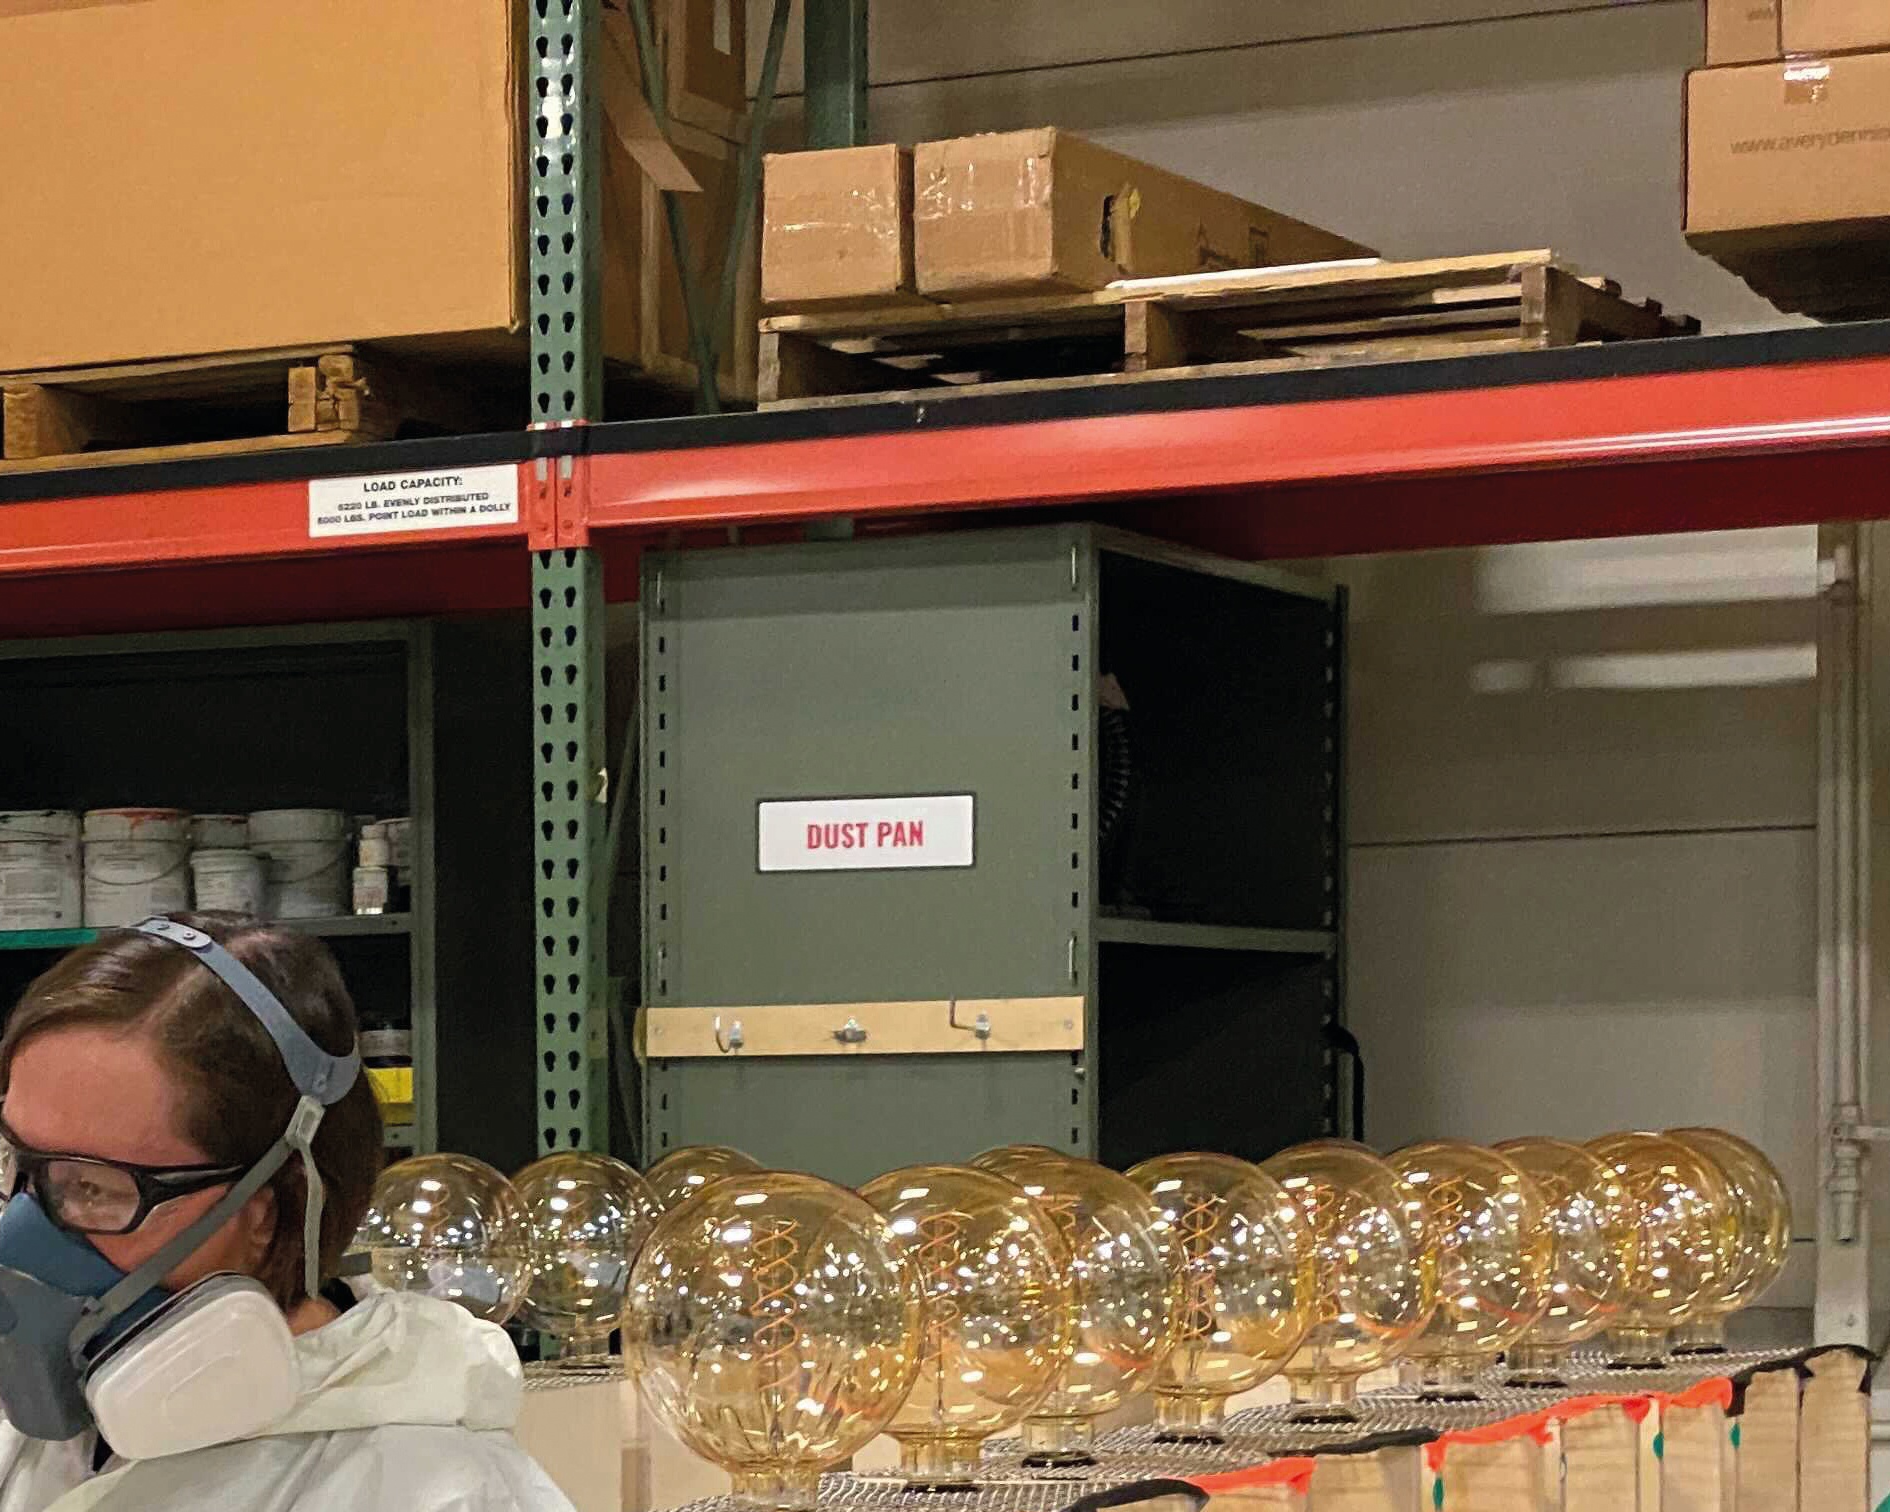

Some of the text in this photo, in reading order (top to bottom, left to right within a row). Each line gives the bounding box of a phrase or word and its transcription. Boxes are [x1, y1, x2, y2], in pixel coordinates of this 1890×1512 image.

[364, 476, 463, 492] LOAD CAPACITY:
[383, 497, 420, 508] EVENLY
[423, 492, 489, 505] DISTRIBUTED
[369, 511, 399, 521] POINT
[402, 508, 428, 518] LOAD
[431, 506, 467, 516] WITHIN
[470, 505, 476, 513] A
[479, 503, 511, 513] DOLLY
[807, 820, 924, 849] DUST PAN
